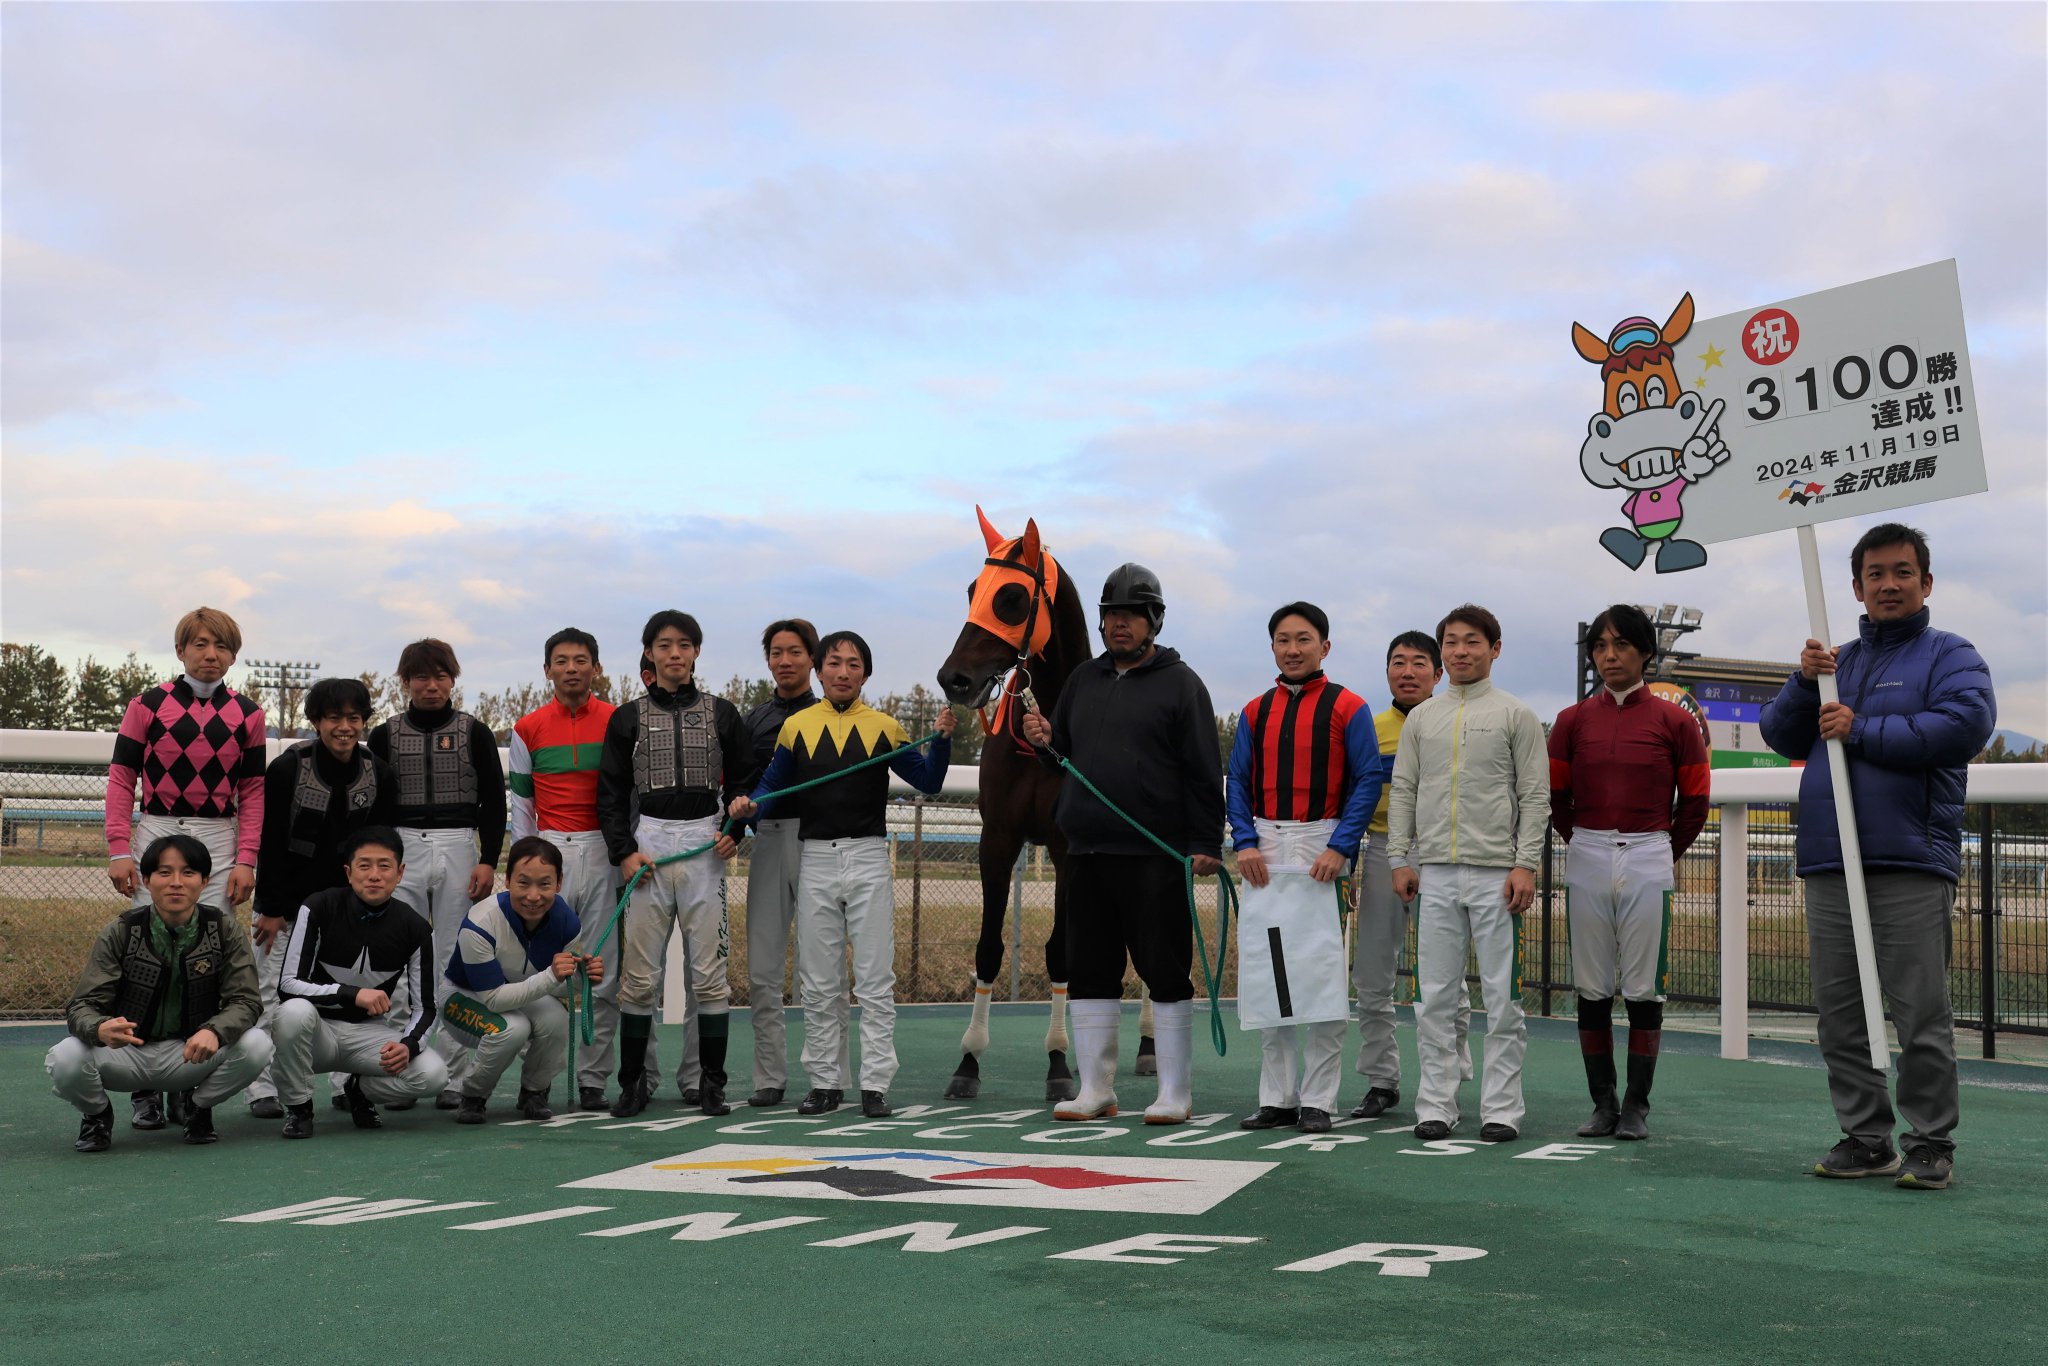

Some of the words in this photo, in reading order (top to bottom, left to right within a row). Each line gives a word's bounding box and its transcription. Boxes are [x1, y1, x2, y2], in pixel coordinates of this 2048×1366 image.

[1750, 316, 1792, 359] 祝
[1746, 344, 1958, 420] 3100勝
[1831, 455, 1938, 497] 金沢競馬
[1267, 926, 1294, 1018] 1
[498, 1110, 1617, 1161] RACECOURSE
[220, 1196, 1490, 1278] WINNER
